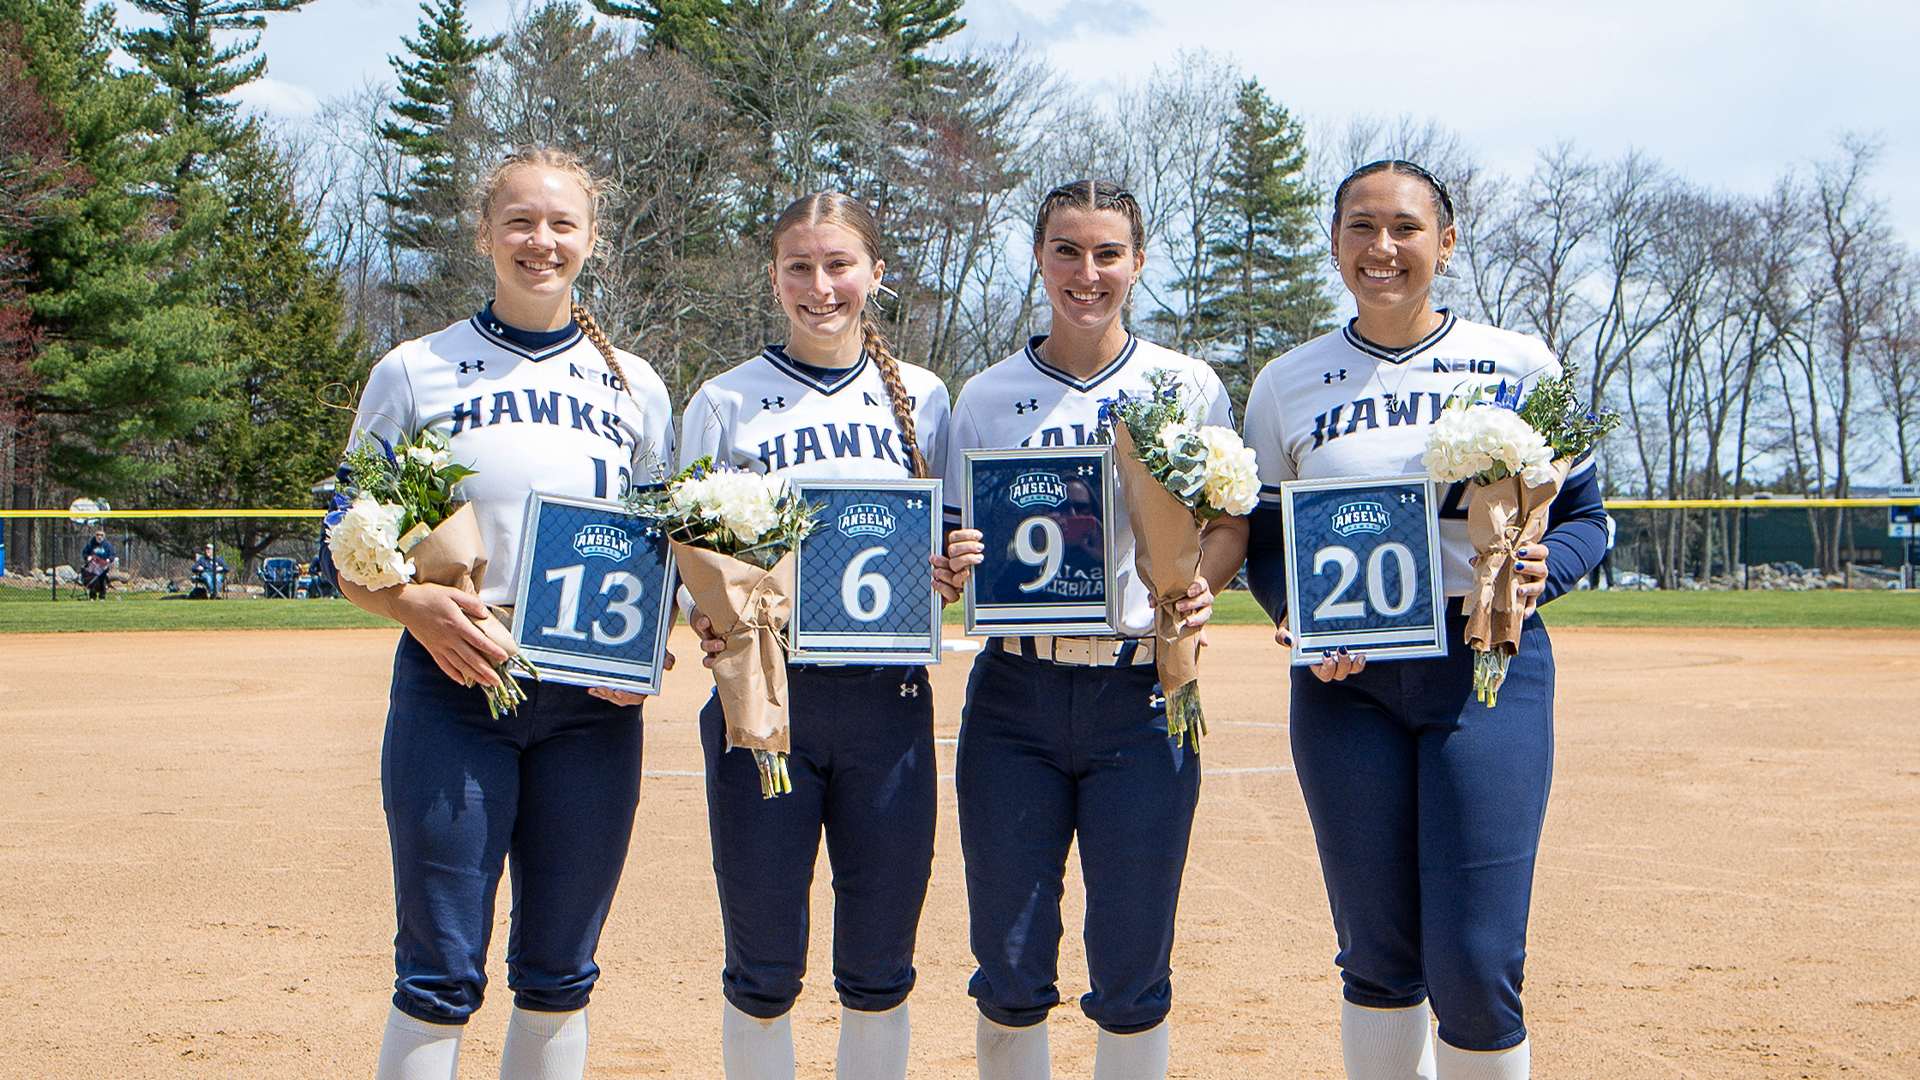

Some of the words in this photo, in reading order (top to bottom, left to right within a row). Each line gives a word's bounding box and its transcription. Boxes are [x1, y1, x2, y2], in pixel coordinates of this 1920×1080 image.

[1433, 358, 1496, 374] NE10
[451, 388, 623, 448] HAWKS
[1013, 482, 1064, 499] ANSELM
[841, 513, 893, 529] ANSELM
[1335, 511, 1388, 529] ANSELM
[576, 534, 629, 556] ANSELM
[1014, 515, 1065, 594] 9
[841, 545, 892, 623] 6
[1313, 541, 1418, 622] 20
[541, 563, 644, 647] 13
